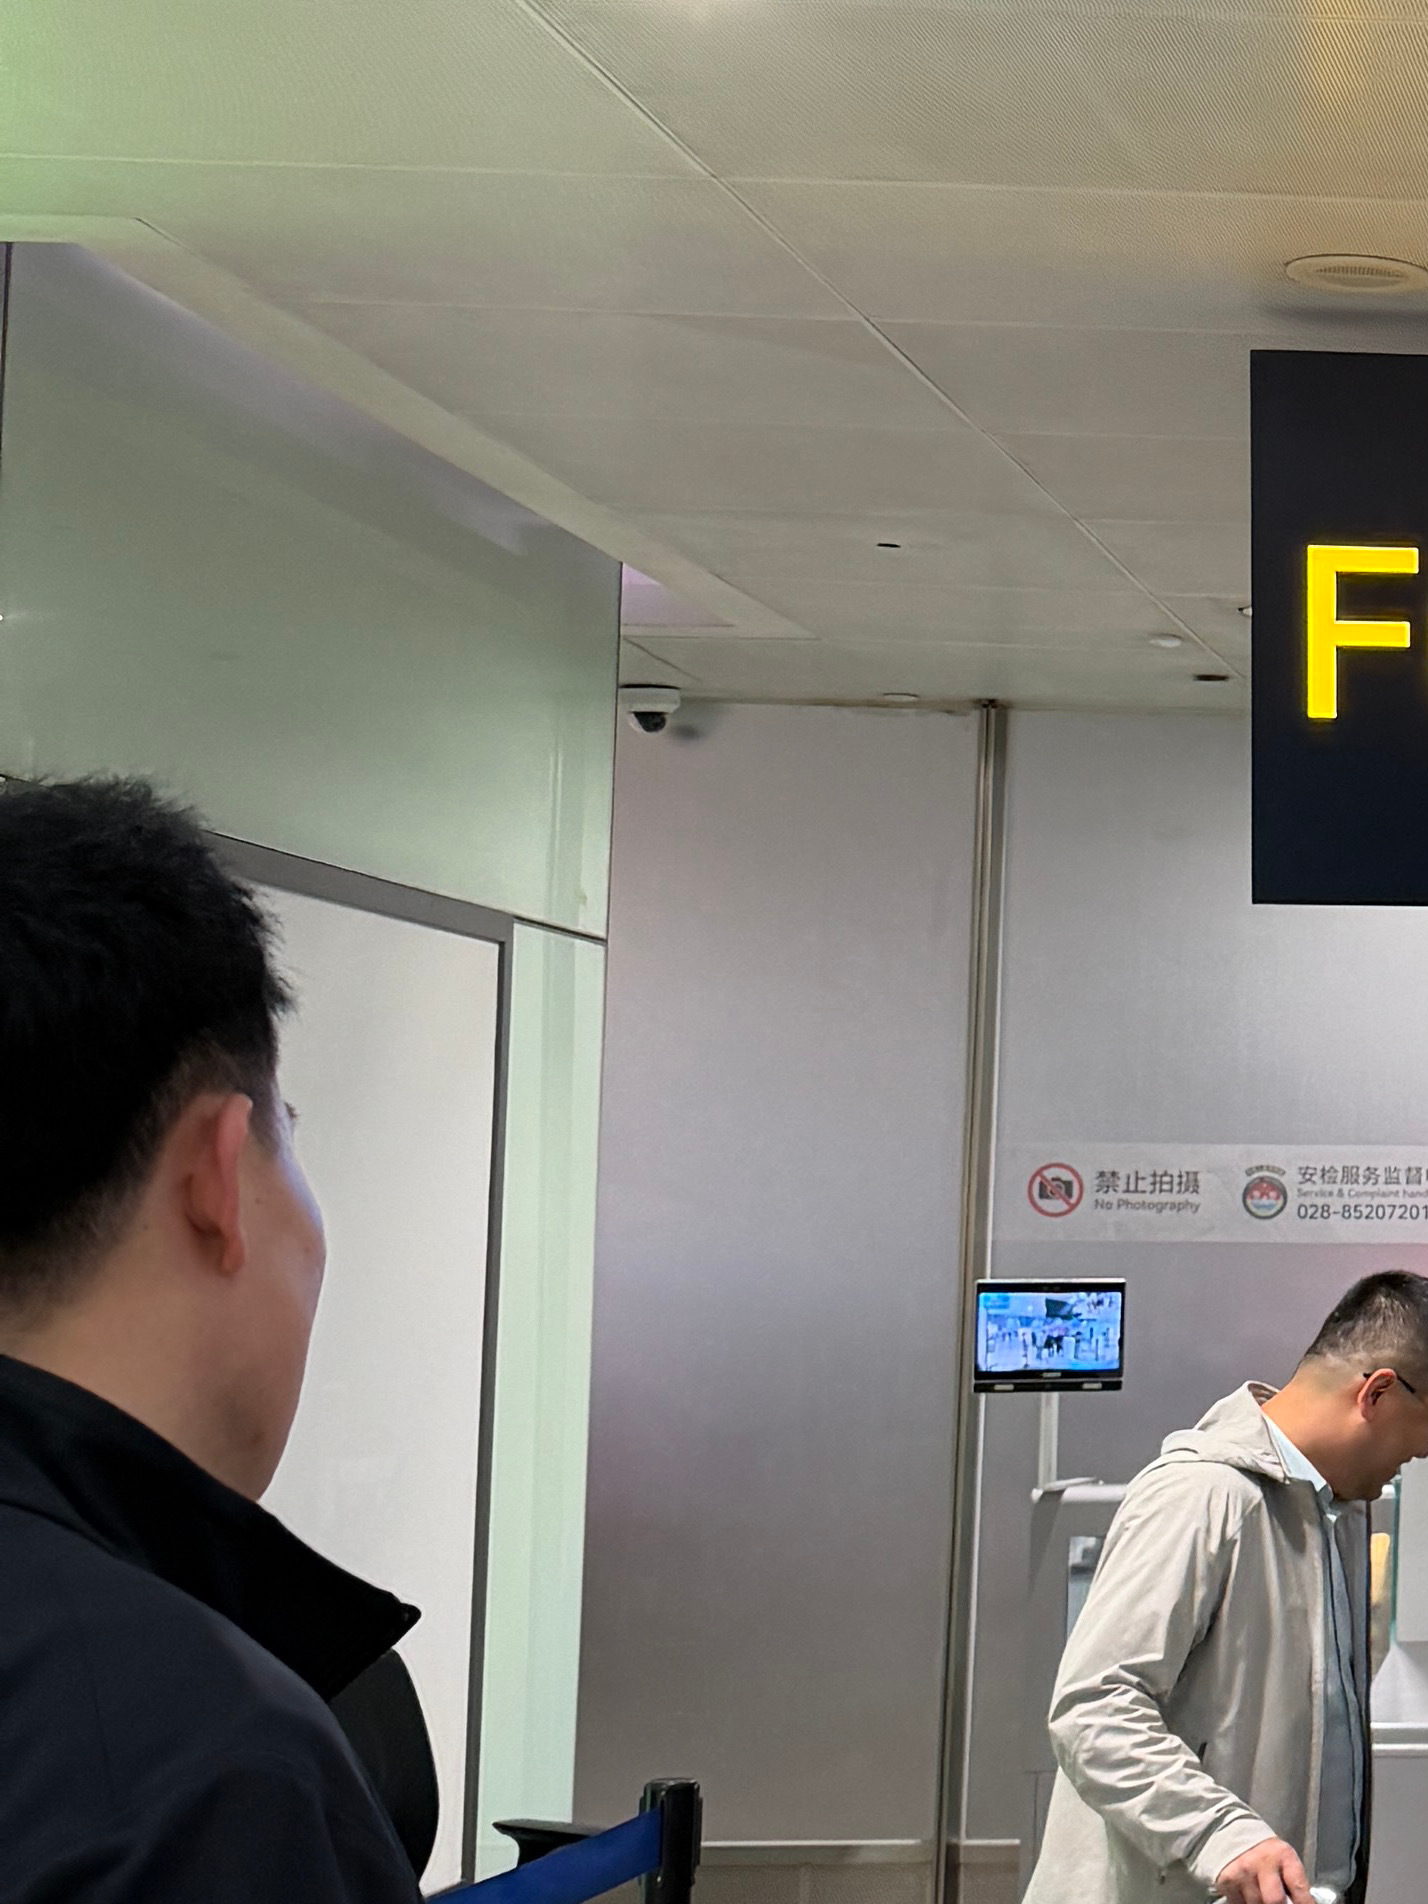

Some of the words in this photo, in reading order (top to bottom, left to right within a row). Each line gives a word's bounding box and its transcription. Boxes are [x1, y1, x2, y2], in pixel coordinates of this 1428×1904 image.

[1095, 1169, 1200, 1195] 禁止拍摄
[1094, 1198, 1113, 1211] No
[1116, 1198, 1201, 1214] Photography
